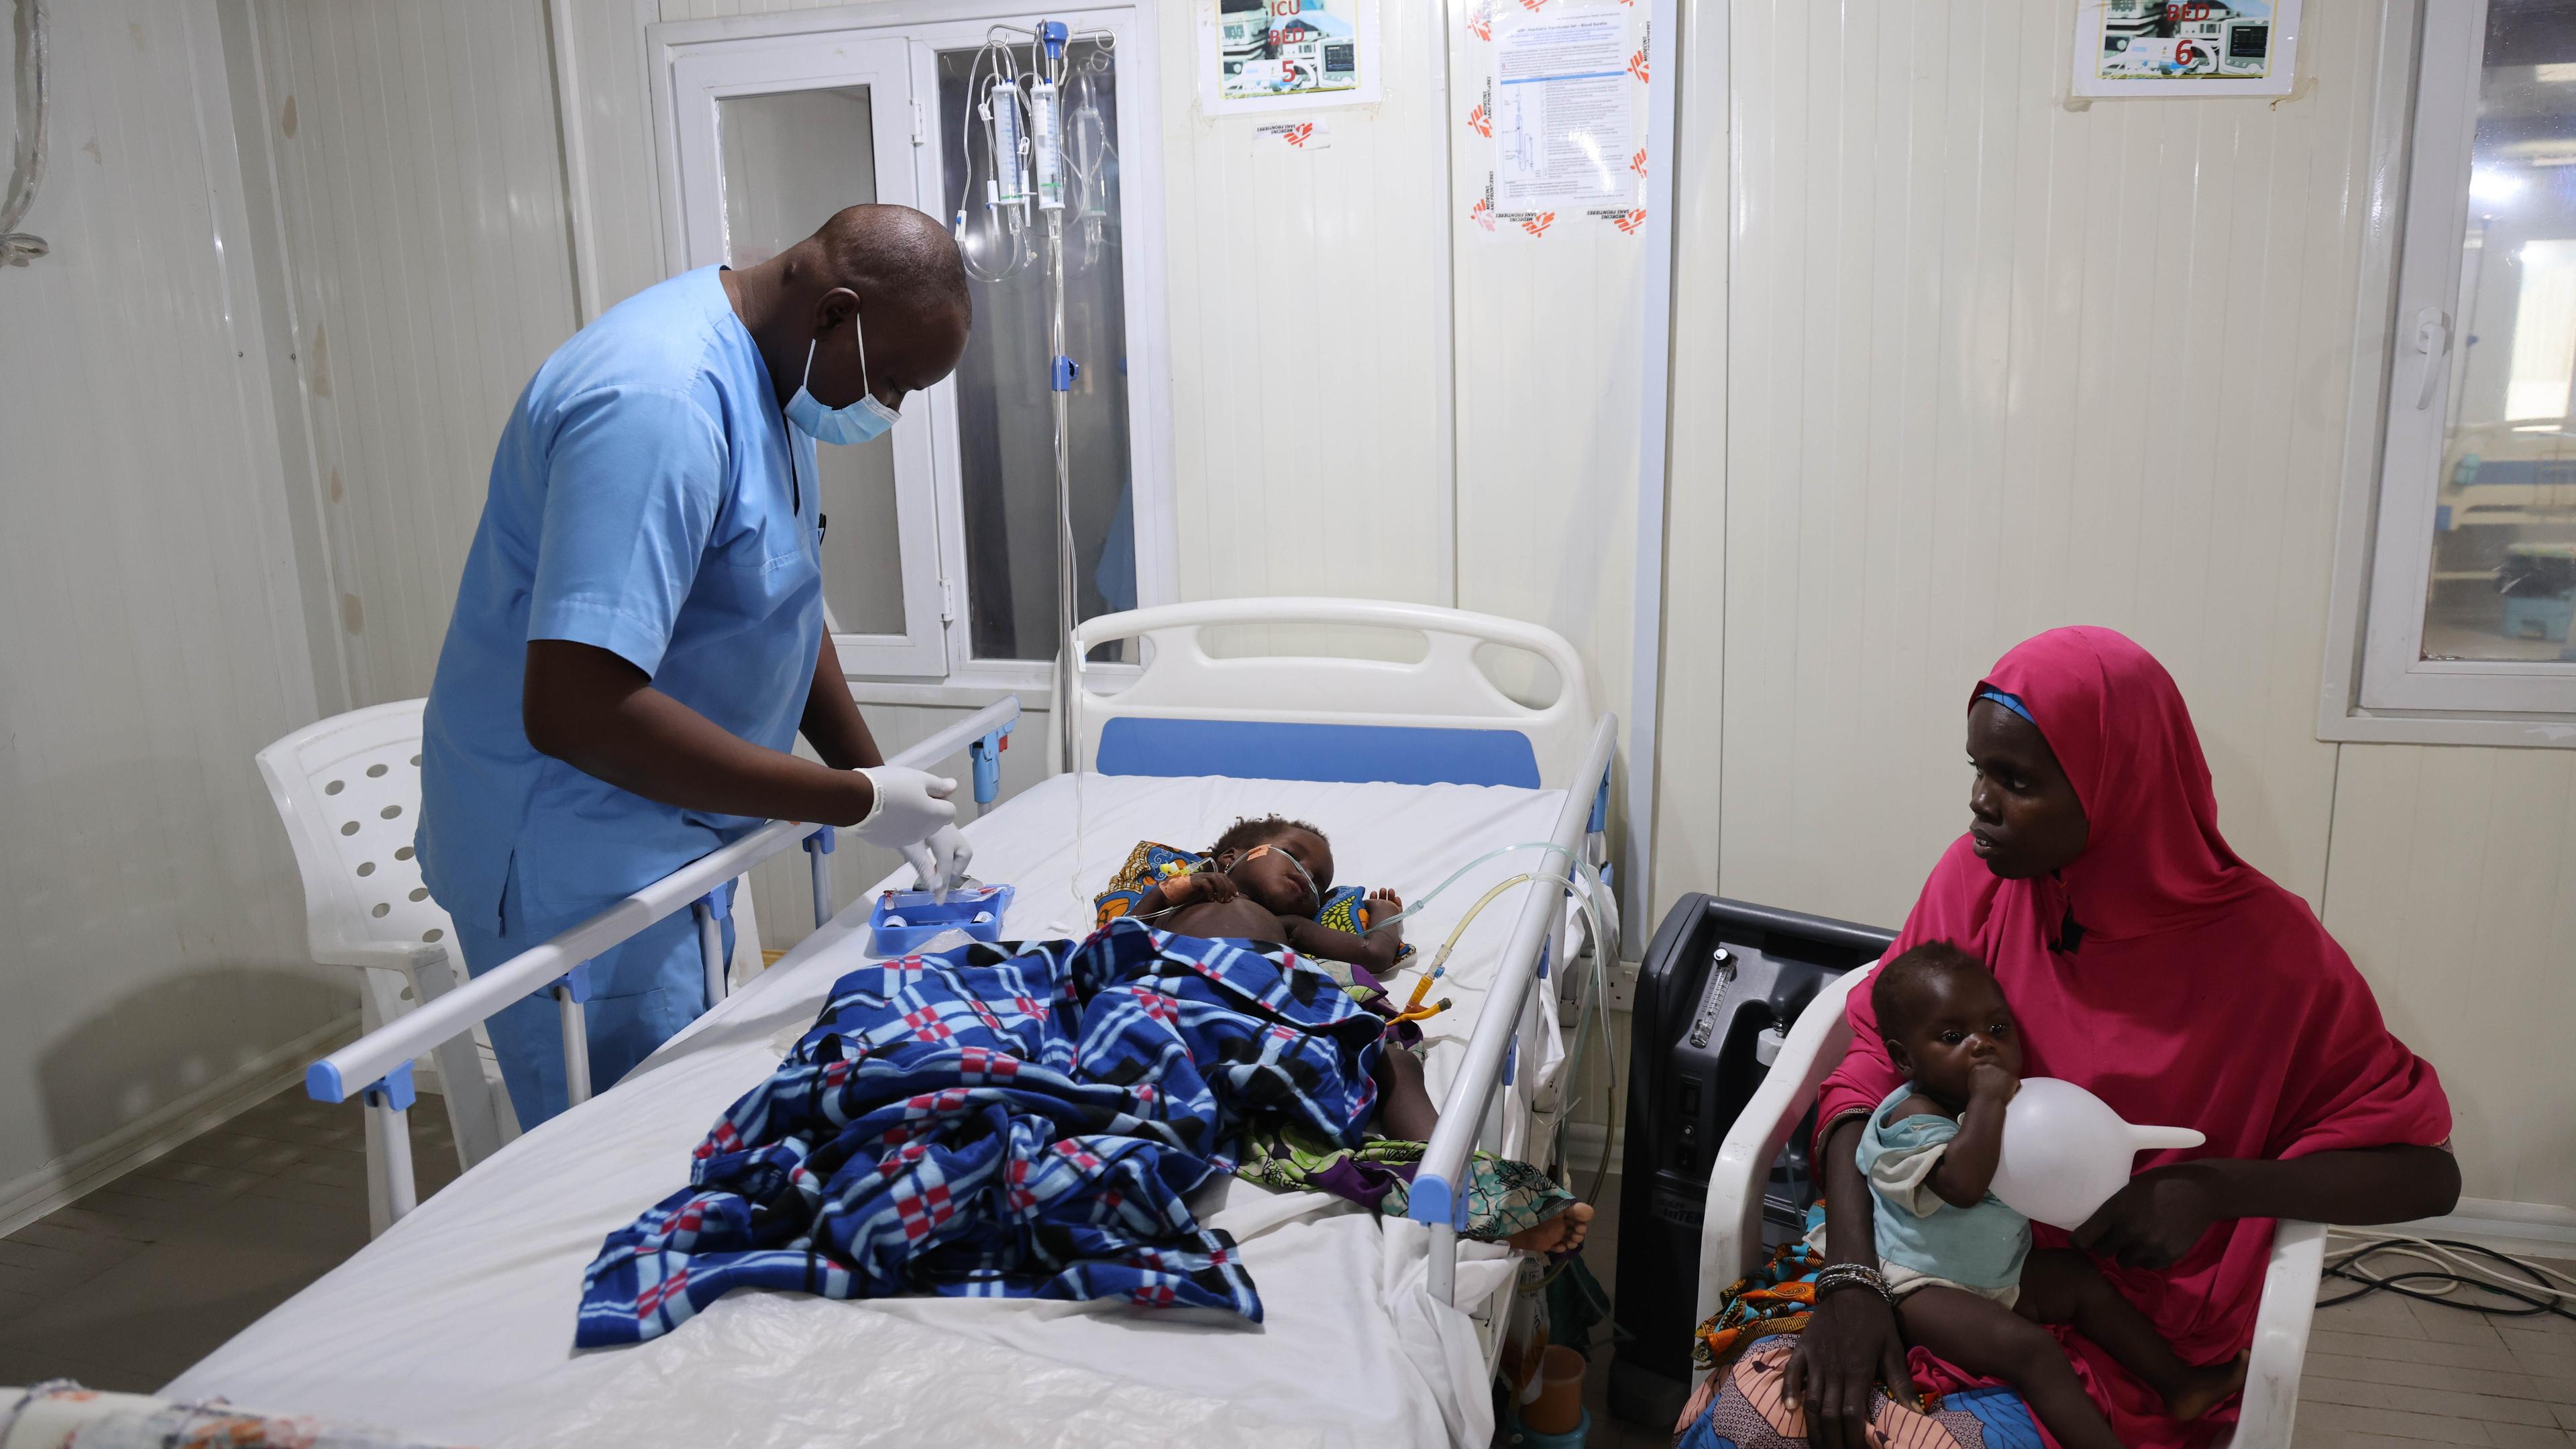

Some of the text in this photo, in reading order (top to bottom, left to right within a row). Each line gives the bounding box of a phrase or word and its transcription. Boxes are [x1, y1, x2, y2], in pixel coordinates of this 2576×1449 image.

[1271, 0, 1301, 16] ICU
[2167, 3, 2210, 21] BED
[1270, 28, 1305, 46] BED
[2176, 39, 2193, 66] 6
[1282, 60, 1296, 83] 5
